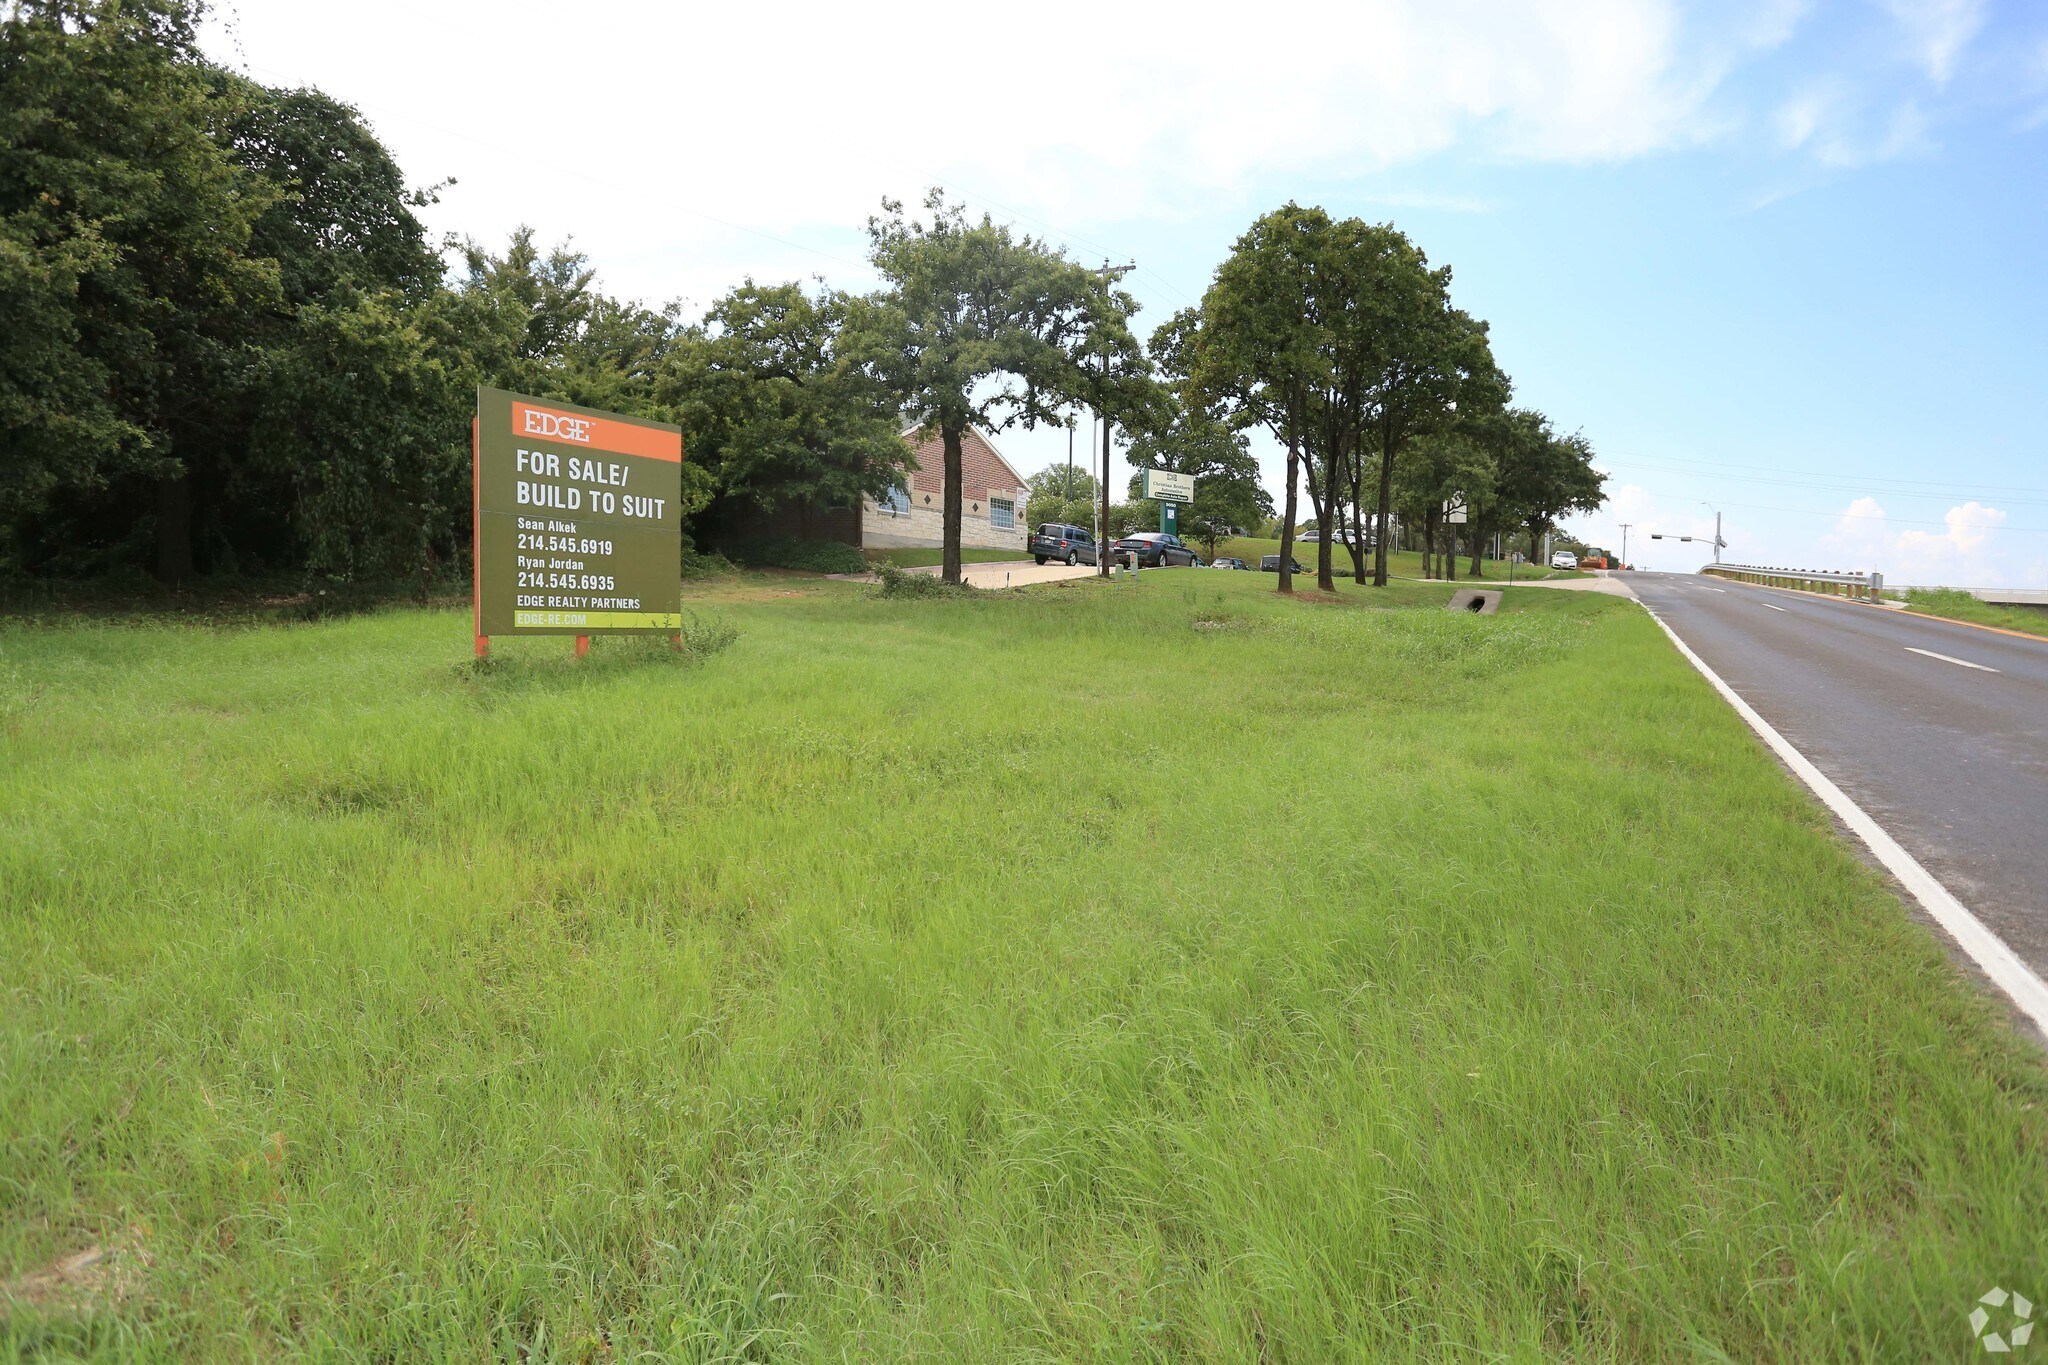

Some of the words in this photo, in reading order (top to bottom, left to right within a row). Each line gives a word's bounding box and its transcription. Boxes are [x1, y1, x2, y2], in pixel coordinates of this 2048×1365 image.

[525, 409, 590, 443] EDGE
[516, 449, 560, 477] FOR
[568, 457, 629, 487] SALE/
[517, 481, 581, 510] BUILD
[589, 490, 615, 515] TO
[622, 494, 665, 520] SUIT
[517, 517, 544, 531] Sean
[548, 520, 577, 533] Alkek
[517, 534, 613, 555] 214.545.6919
[517, 556, 545, 570] Ryan
[548, 557, 584, 570] Jordan
[518, 572, 615, 590] 214.545.6935
[517, 595, 544, 607] EDGE
[548, 596, 588, 608] REALTY
[591, 597, 640, 609] PARTNERS
[517, 613, 587, 625] EDGE-RE.COM
